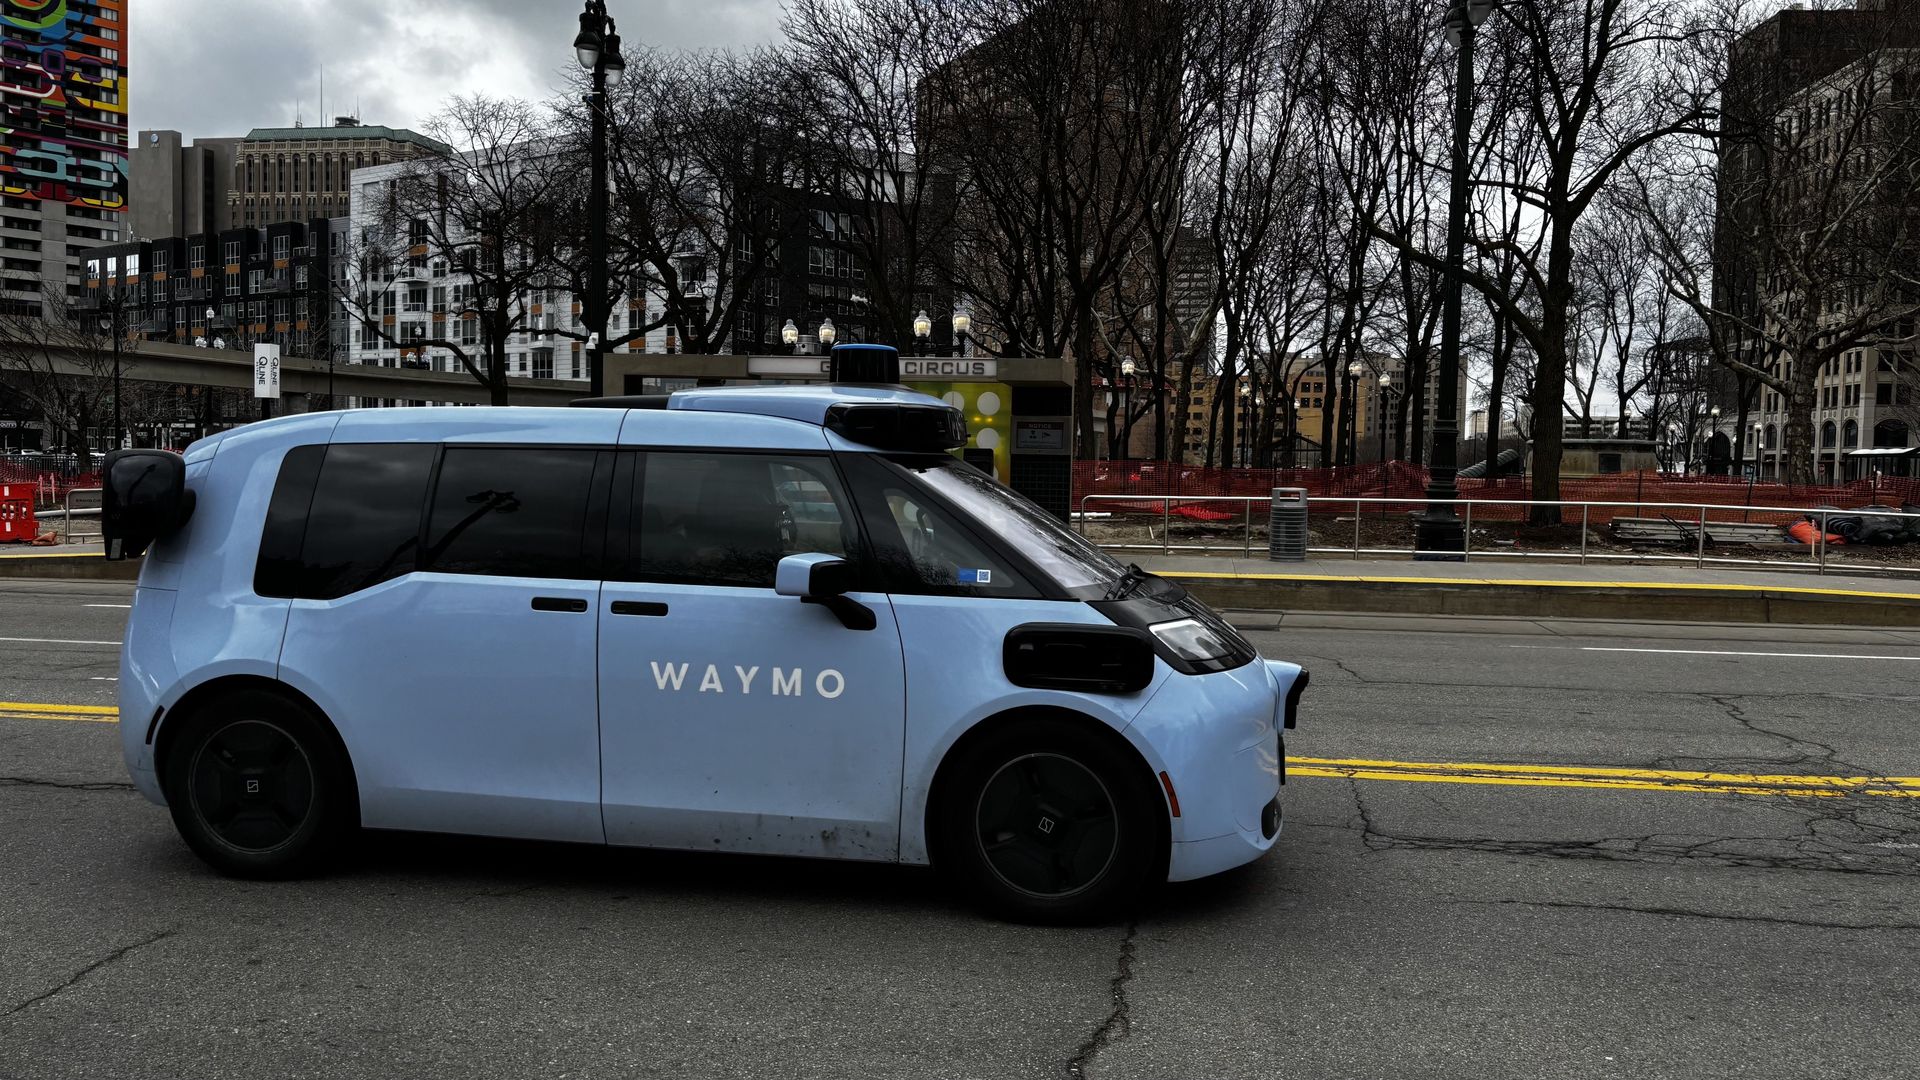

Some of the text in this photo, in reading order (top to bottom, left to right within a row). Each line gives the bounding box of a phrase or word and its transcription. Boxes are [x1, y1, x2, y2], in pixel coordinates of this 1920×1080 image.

[259, 356, 268, 385] QLINE
[904, 361, 985, 375] CIRCUS
[650, 661, 845, 699] WAYMO
